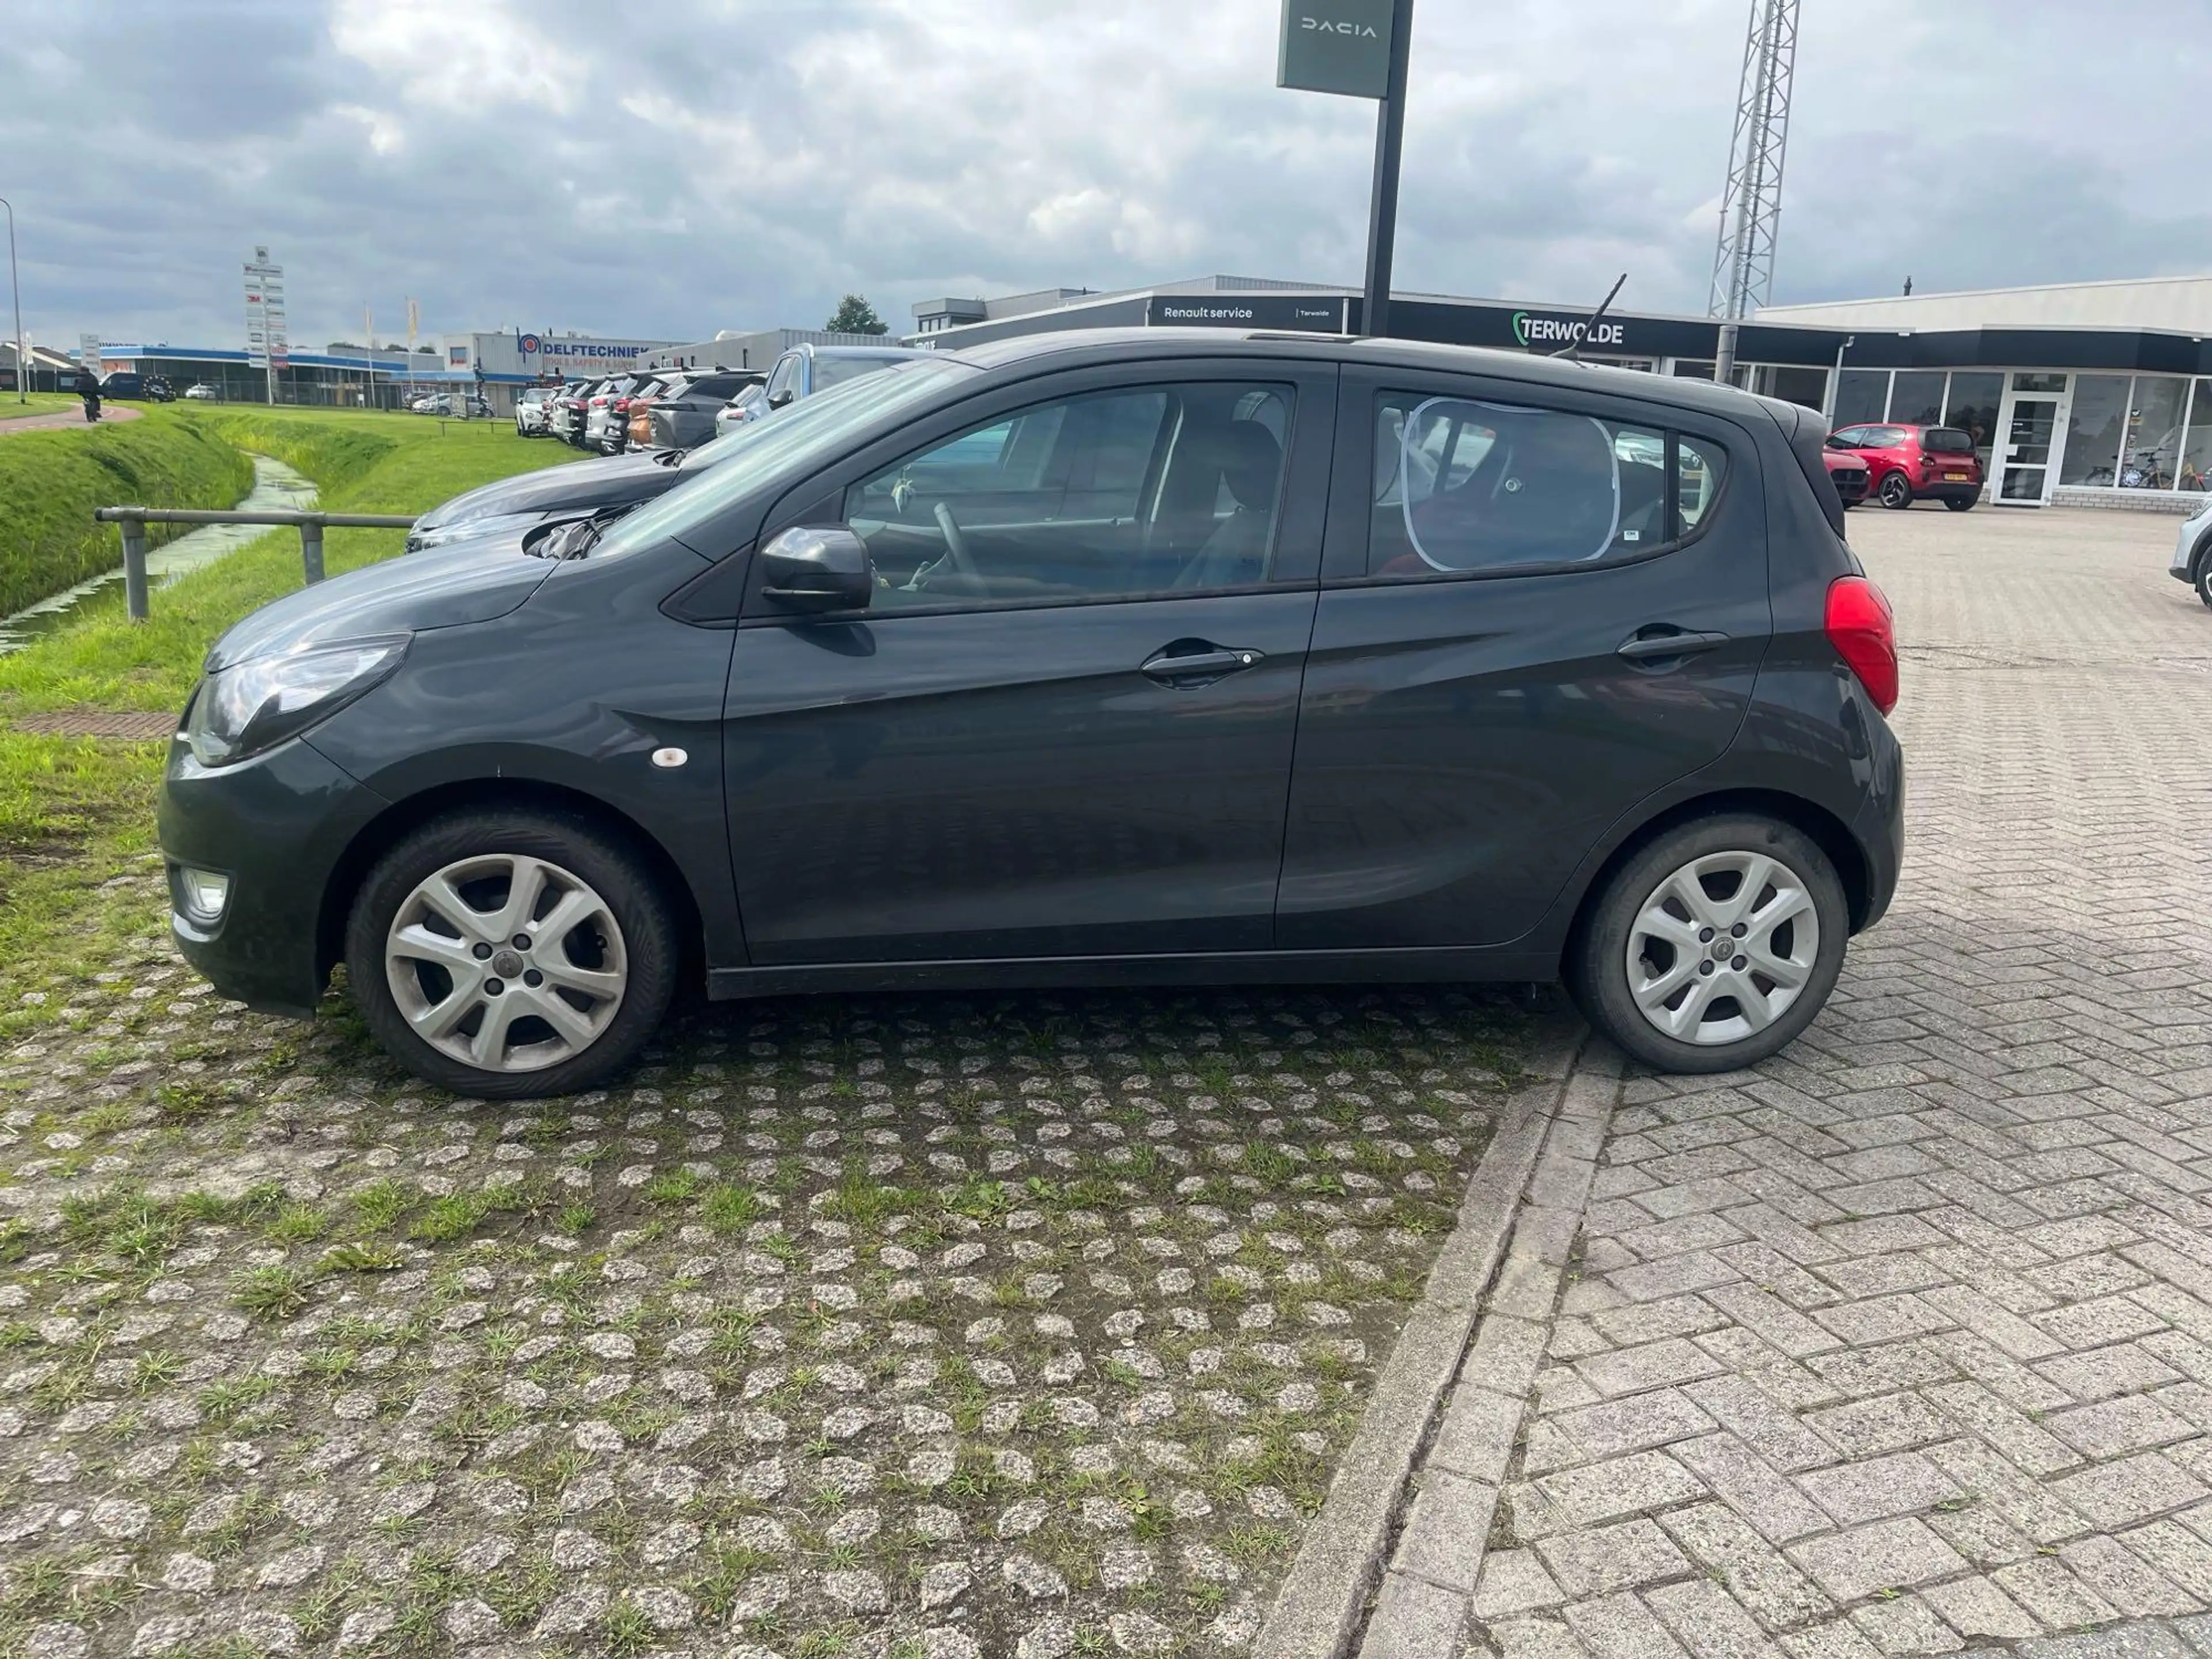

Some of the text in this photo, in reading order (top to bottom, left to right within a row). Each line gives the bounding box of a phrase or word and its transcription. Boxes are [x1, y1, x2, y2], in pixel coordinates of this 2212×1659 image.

[1301, 17, 1377, 37] DACIA
[1164, 307, 1253, 318] Renault service
[1521, 319, 1623, 344] TERWOLDE
